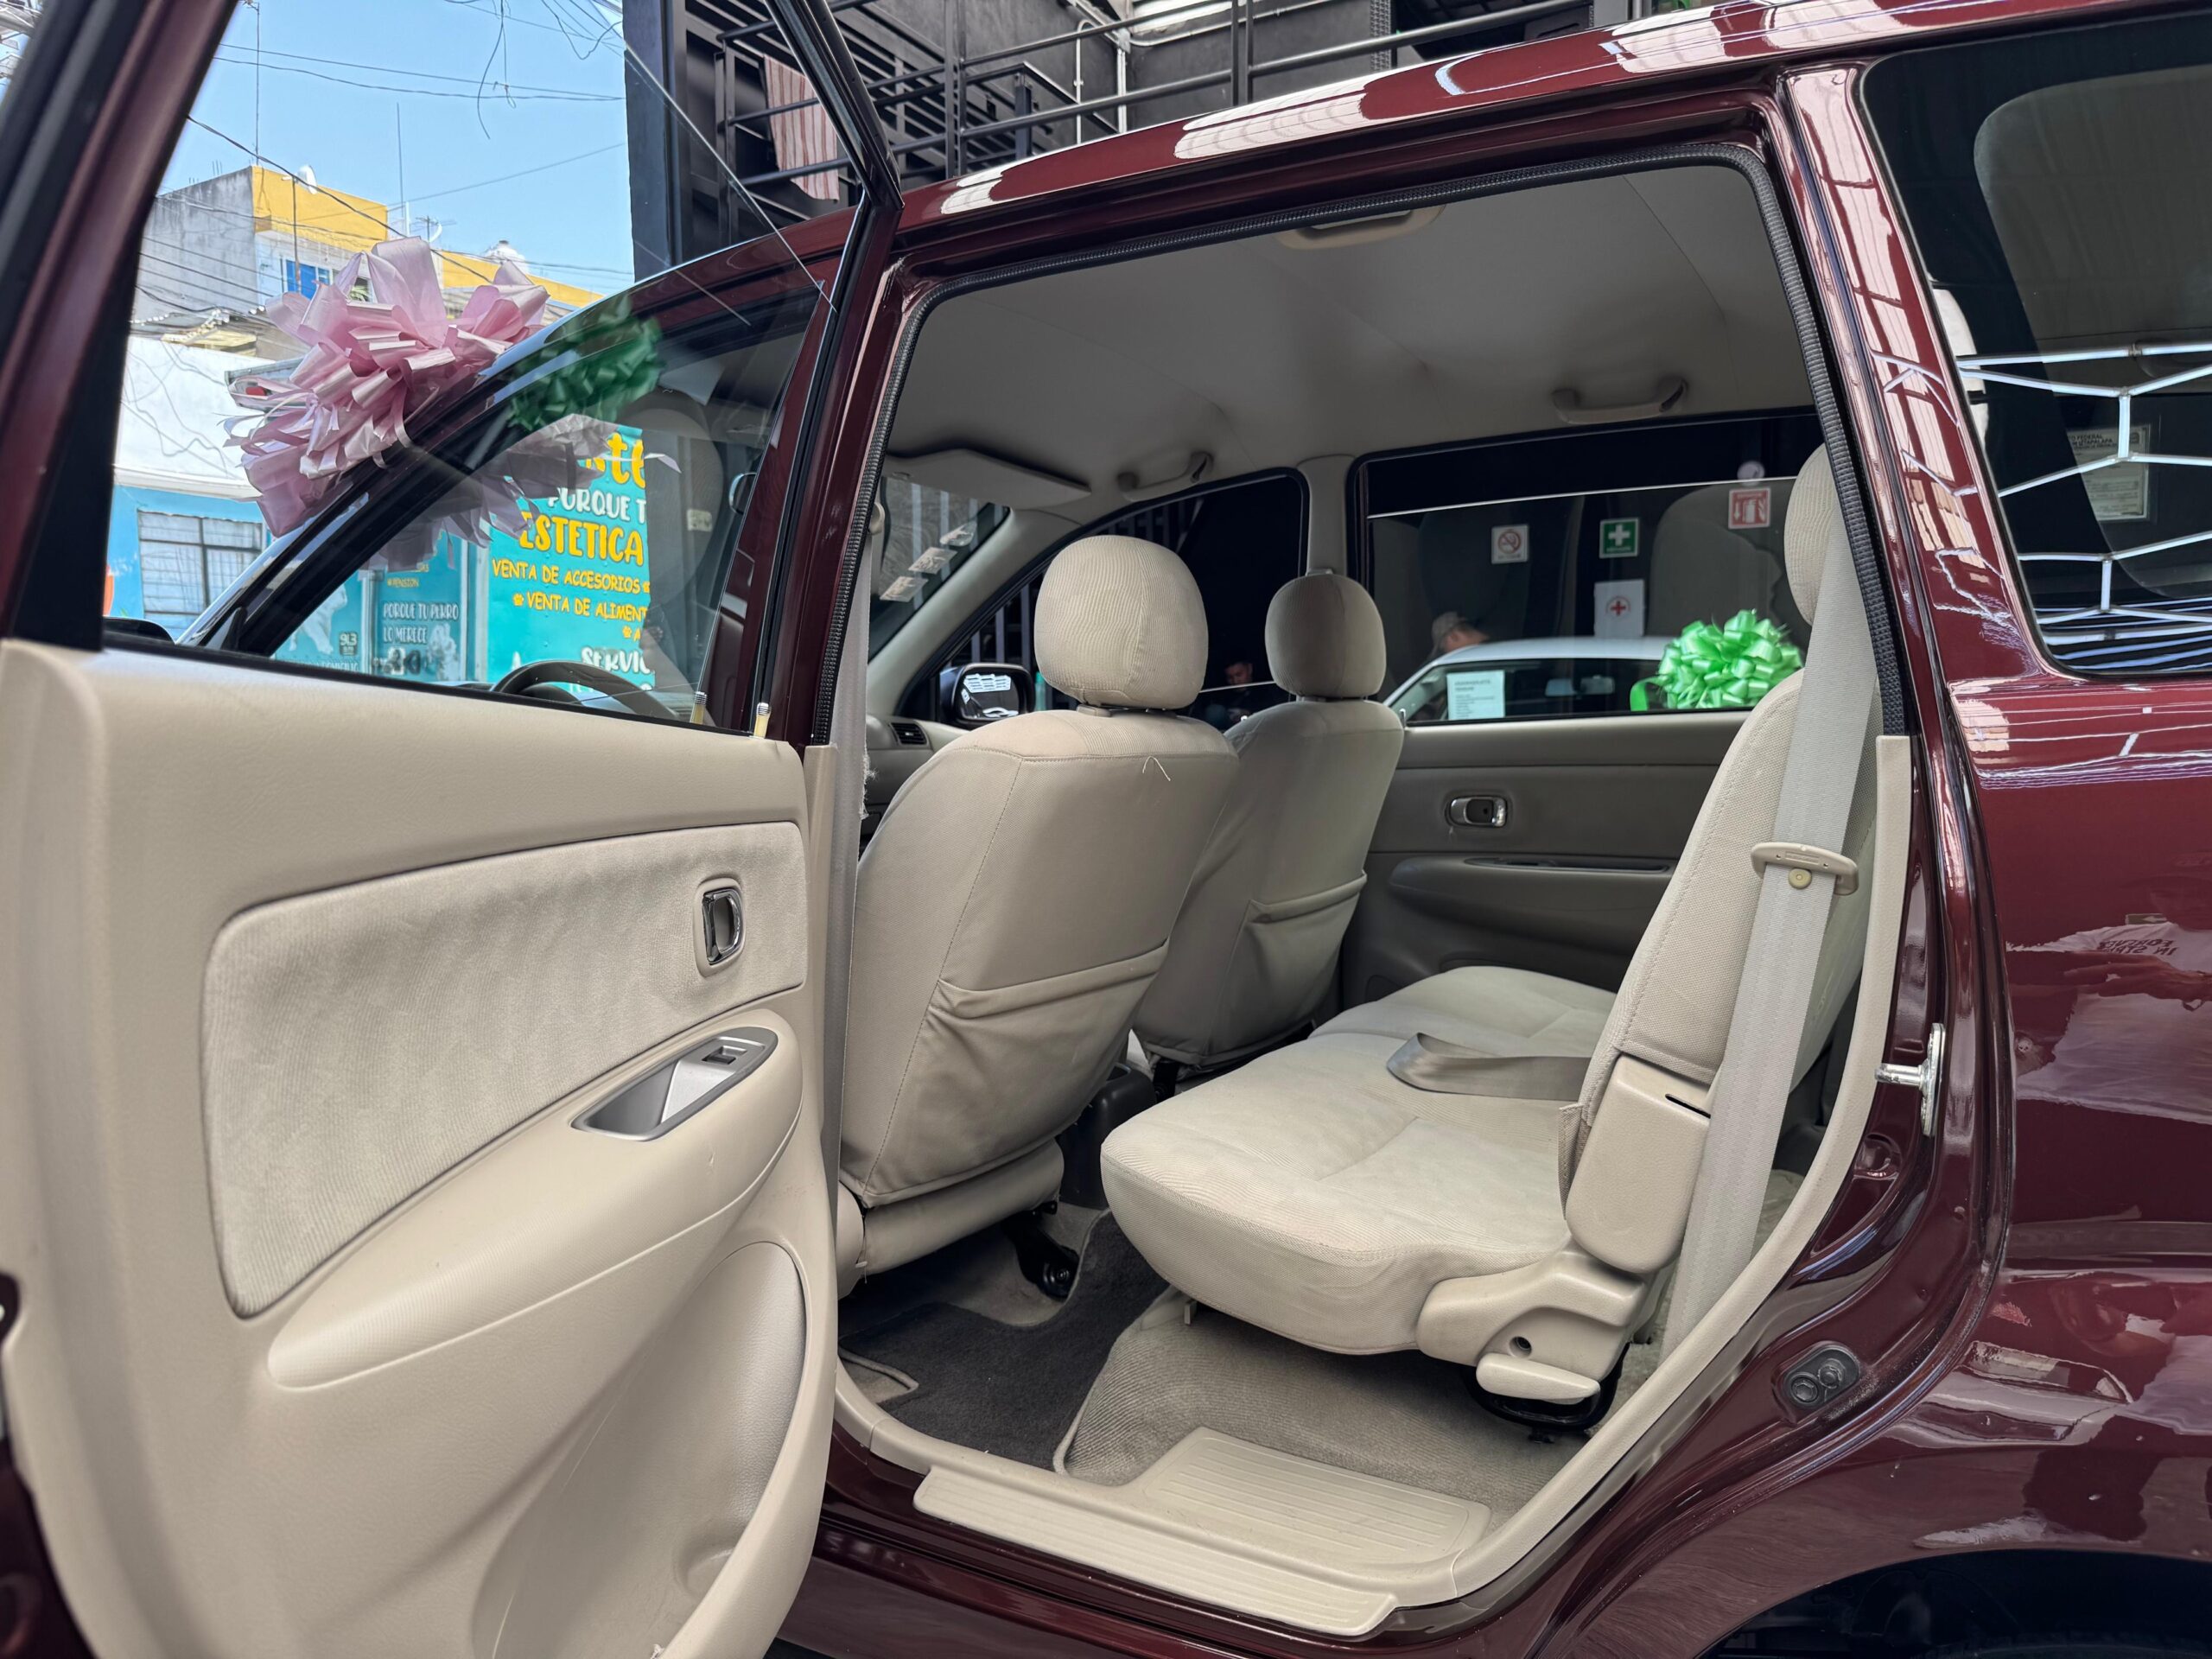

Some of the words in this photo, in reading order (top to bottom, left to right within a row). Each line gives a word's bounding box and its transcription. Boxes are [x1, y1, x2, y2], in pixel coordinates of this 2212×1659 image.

[519, 511, 644, 566] ESTETICA
[492, 559, 537, 581] VENTA
[542, 564, 560, 585] DE
[564, 569, 640, 594] ACCESORIOS
[383, 602, 416, 620] PORQUE
[418, 603, 429, 620] TU
[431, 603, 459, 621] PERRO
[526, 591, 569, 613] VENTA
[574, 597, 591, 617] DE
[595, 602, 648, 622] ALIMENT
[383, 626, 393, 644] LO
[395, 626, 427, 644] MERECE
[581, 646, 651, 674] SERVIC
